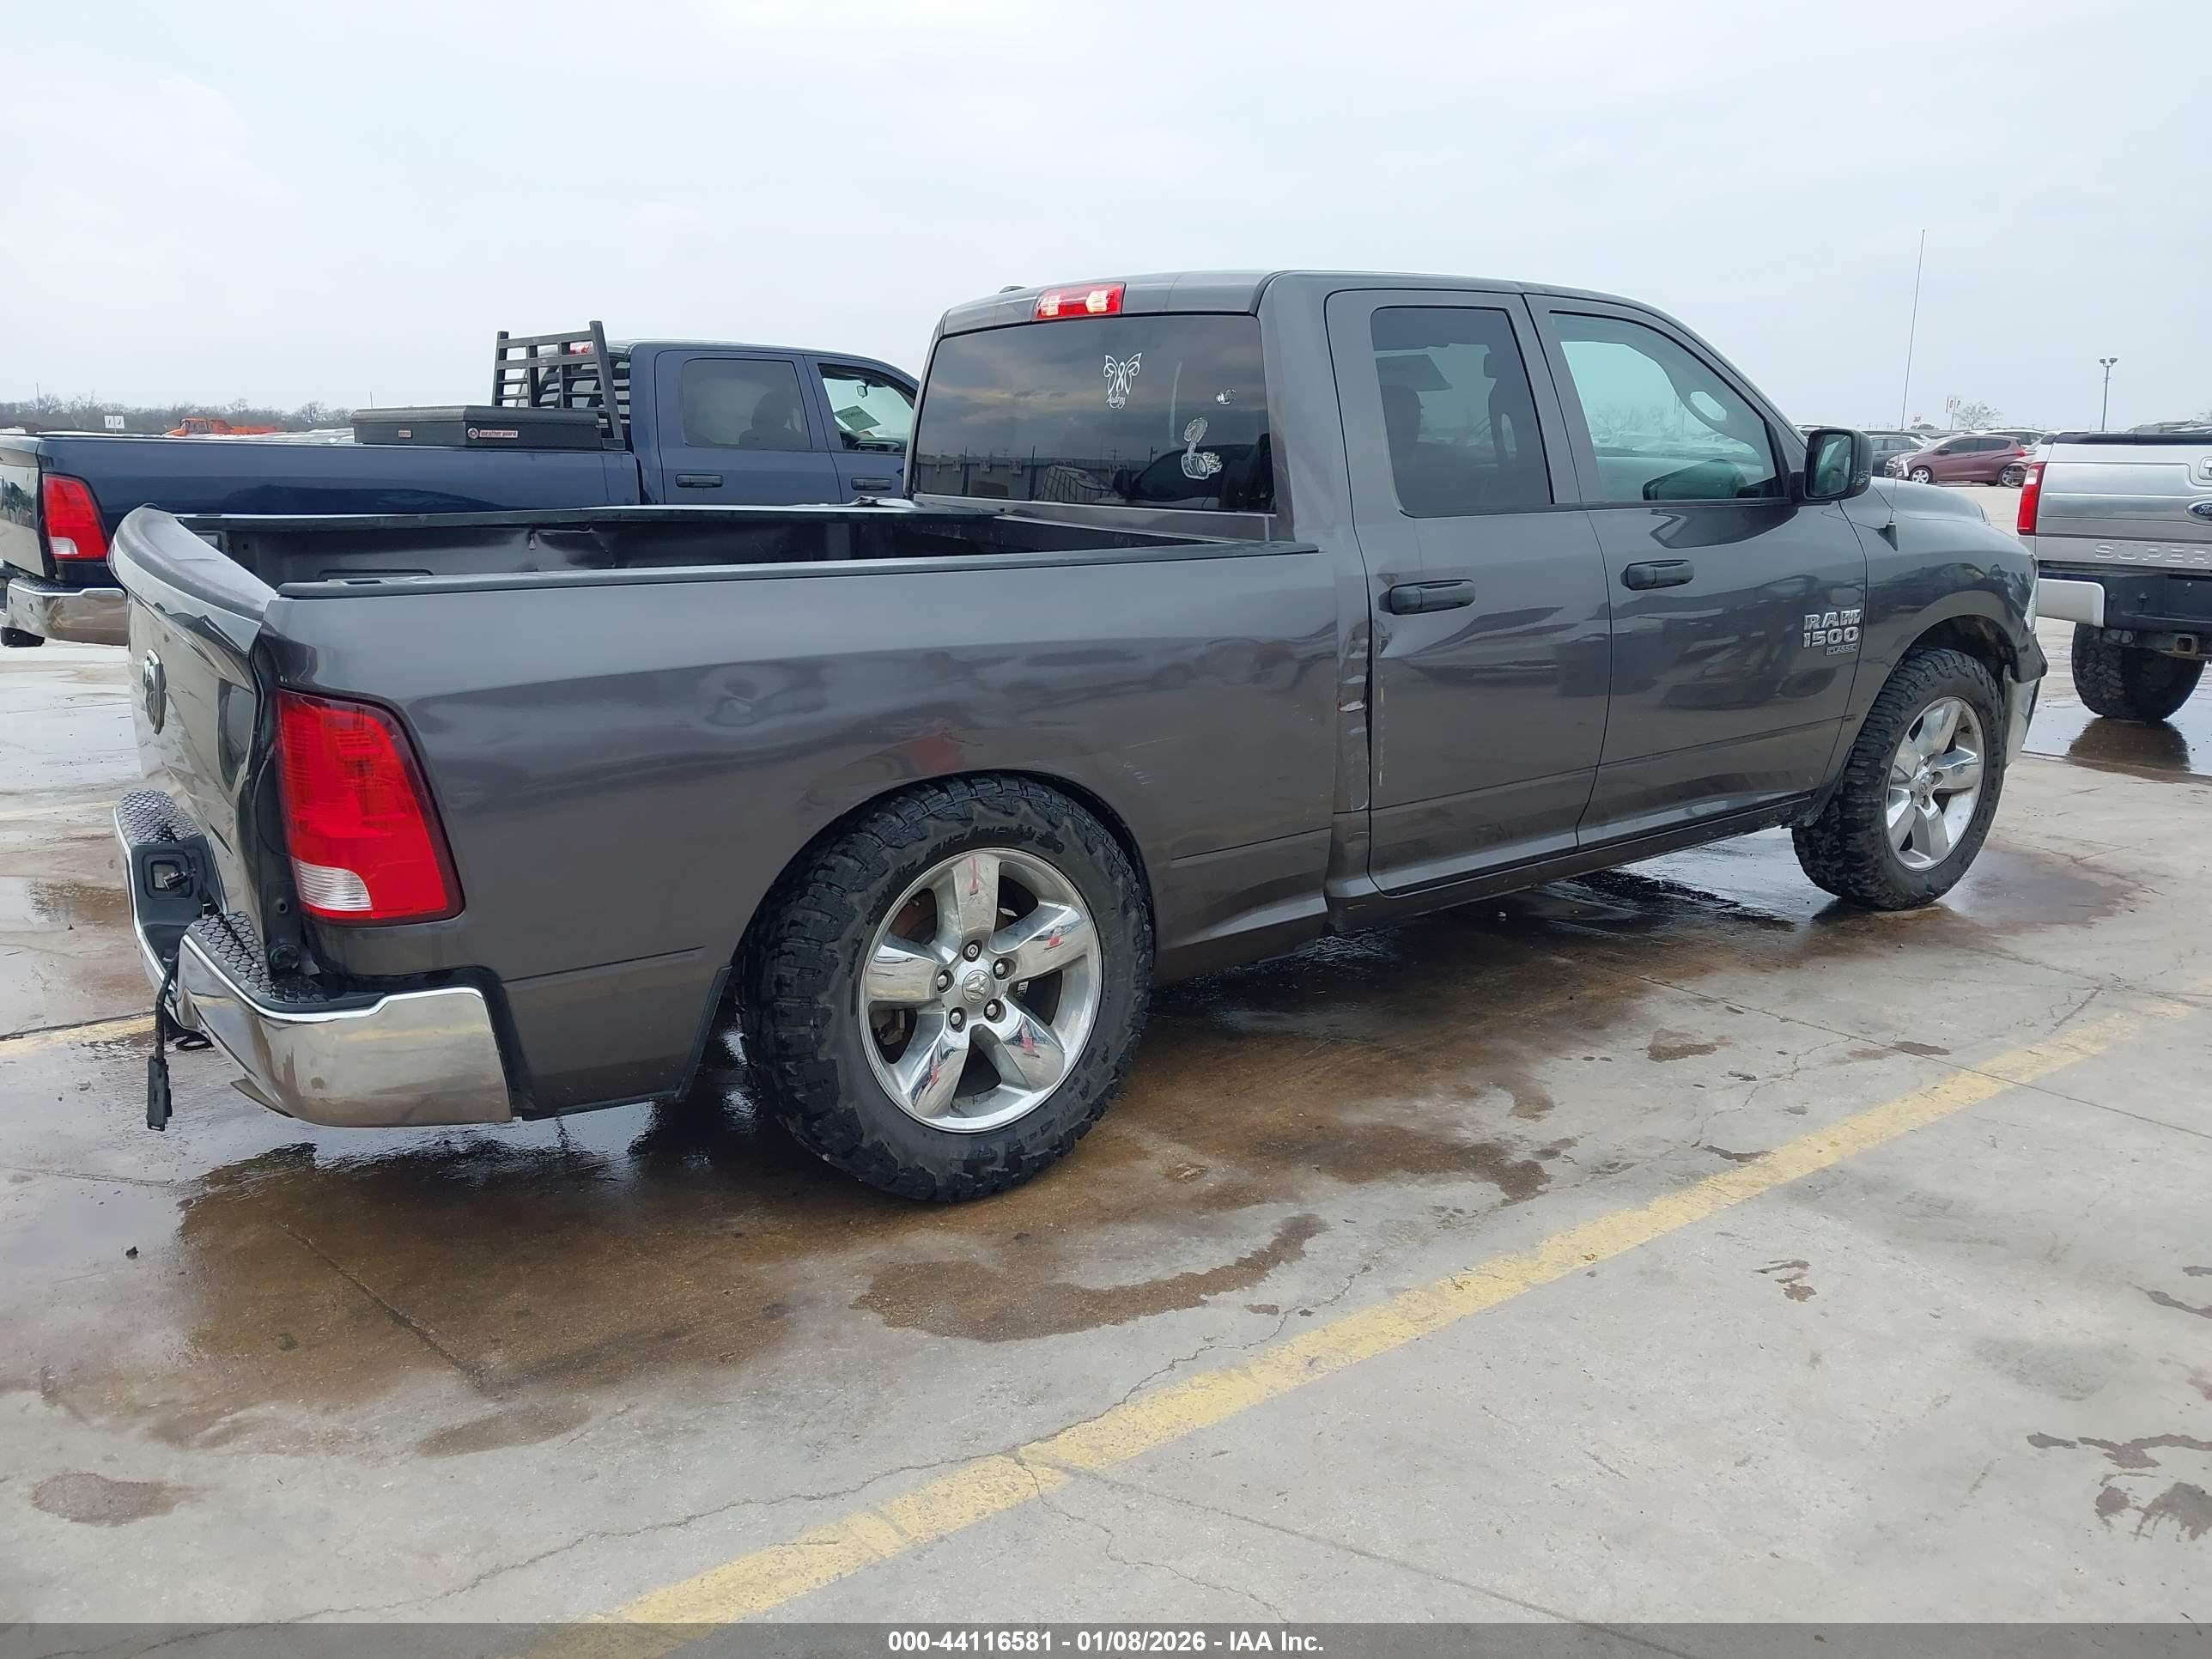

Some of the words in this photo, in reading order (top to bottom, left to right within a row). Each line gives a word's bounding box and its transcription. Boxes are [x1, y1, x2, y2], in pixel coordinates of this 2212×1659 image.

[2094, 543, 2211, 564] SUPER
[1804, 609, 1861, 630] RAM
[1803, 627, 1859, 647] 1500
[1828, 644, 1856, 653] CLASSIC
